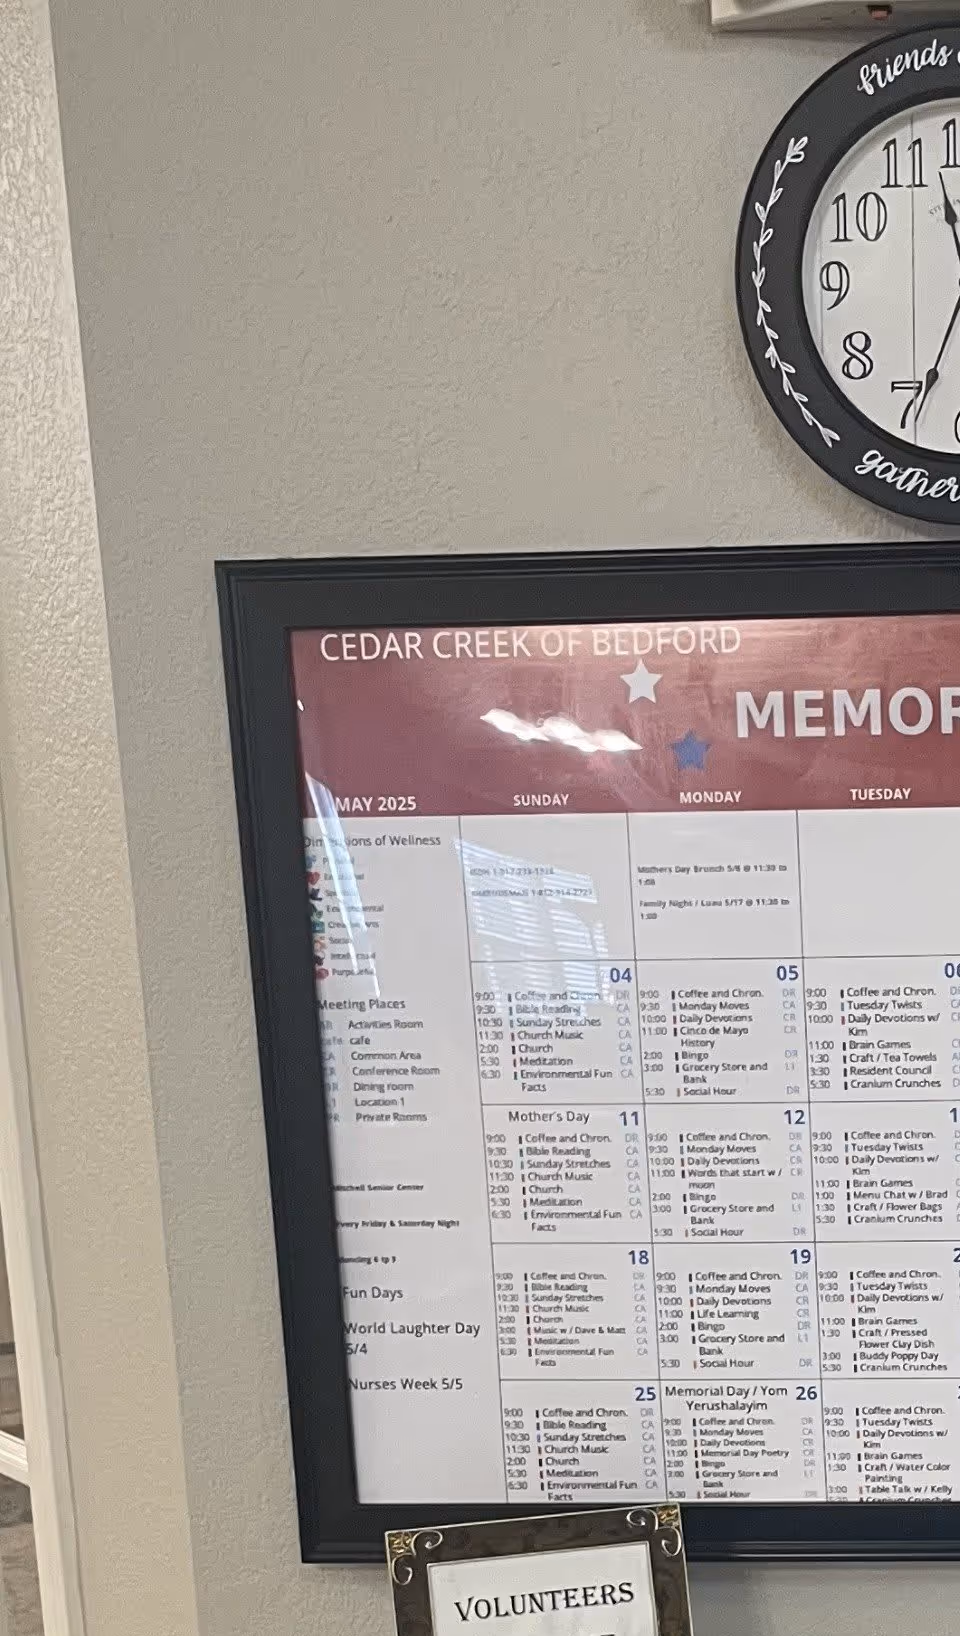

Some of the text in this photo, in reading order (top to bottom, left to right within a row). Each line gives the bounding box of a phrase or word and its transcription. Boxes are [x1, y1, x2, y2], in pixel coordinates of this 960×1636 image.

[856, 39, 953, 95] friends
[881, 138, 930, 189] 11
[830, 192, 888, 243] 10
[820, 260, 851, 311] 9
[842, 331, 875, 380] 8
[891, 380, 924, 430] 7
[319, 625, 742, 661] CEDAR CREEK OF BEDFORD
[513, 794, 569, 806] SUNDAY
[678, 790, 741, 804] MONDAY
[849, 787, 912, 801] TUESDAY
[337, 797, 416, 811] MAY 2025
[375, 834, 386, 846] of
[389, 834, 441, 846] Wellness
[609, 968, 632, 982] 04
[777, 966, 798, 980] 05
[369, 999, 405, 1009] Places
[848, 1000, 922, 1011] Tuesday Twists
[349, 1020, 423, 1029] Activities Room
[849, 1027, 867, 1036] Kim
[350, 1036, 370, 1045] cafe
[351, 1052, 421, 1060] Common Area
[353, 1067, 440, 1075] Conference Room
[850, 1065, 932, 1076] Resident Council
[354, 1082, 413, 1093] Dining room
[851, 1078, 941, 1088] Cranium Crunches
[684, 1086, 736, 1096] Social Hour
[355, 1098, 398, 1106] Location
[356, 1113, 427, 1122] Private Rooms
[509, 1111, 590, 1125] Mother's Day
[619, 1112, 639, 1126] 11
[784, 1110, 805, 1124] 12
[628, 1250, 649, 1265] 18
[790, 1249, 811, 1264] 19
[343, 1286, 403, 1301] Fun Days
[344, 1322, 480, 1337] World Laughter Day
[346, 1343, 368, 1355] 5/4
[859, 1339, 934, 1350] Flower Clay Dish
[860, 1351, 938, 1362] Buddy Poppy Day
[349, 1378, 463, 1390] Nurses Week 5/5
[635, 1386, 656, 1401] 25
[665, 1386, 788, 1399] Memorial Day / Yom
[796, 1386, 817, 1400] 26
[686, 1400, 768, 1413] Yerushalayim
[454, 1581, 634, 1622] VOLUNTEERS
